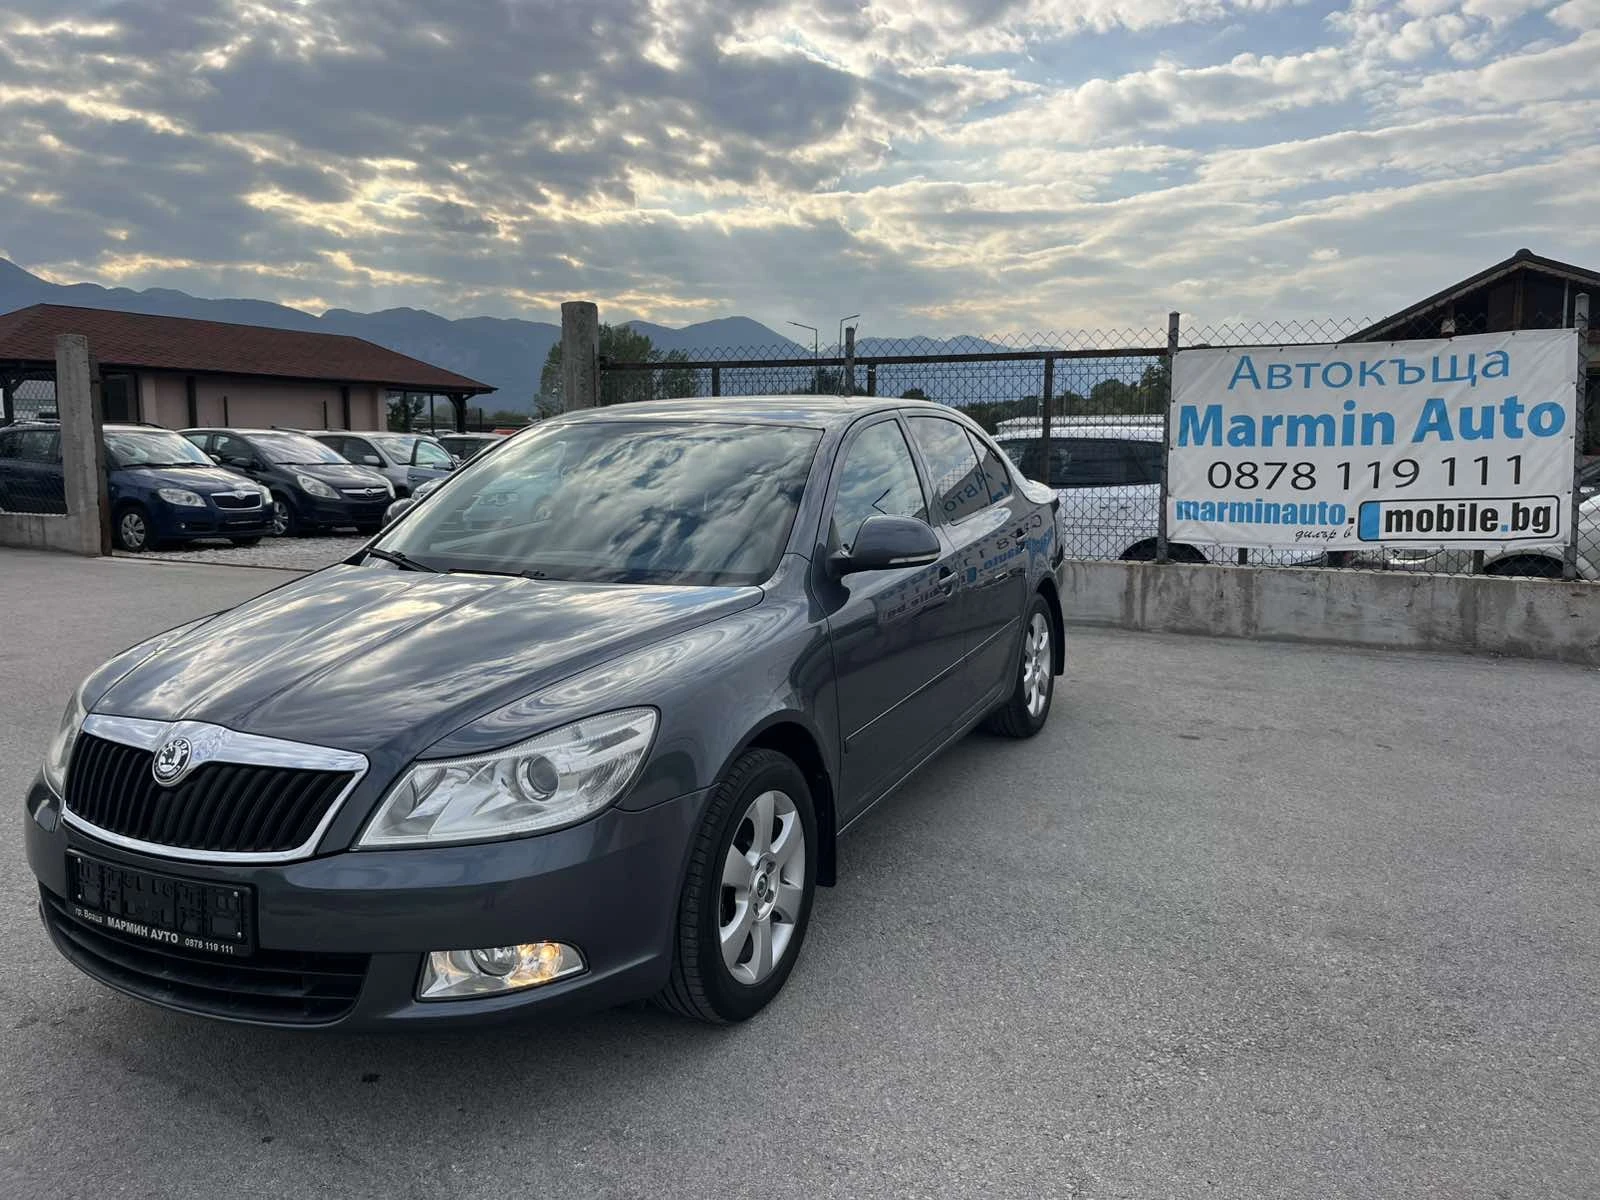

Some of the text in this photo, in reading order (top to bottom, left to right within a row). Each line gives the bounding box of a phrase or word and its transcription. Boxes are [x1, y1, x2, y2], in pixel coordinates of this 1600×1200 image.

[1228, 351, 1510, 390] Автокъща
[1178, 395, 1566, 447] Marmin Auto
[1207, 454, 1522, 491] 0878 119 111
[1385, 502, 1551, 533] mobile.bg
[107, 916, 148, 937] МАРМИН
[150, 929, 178, 944] АУТО
